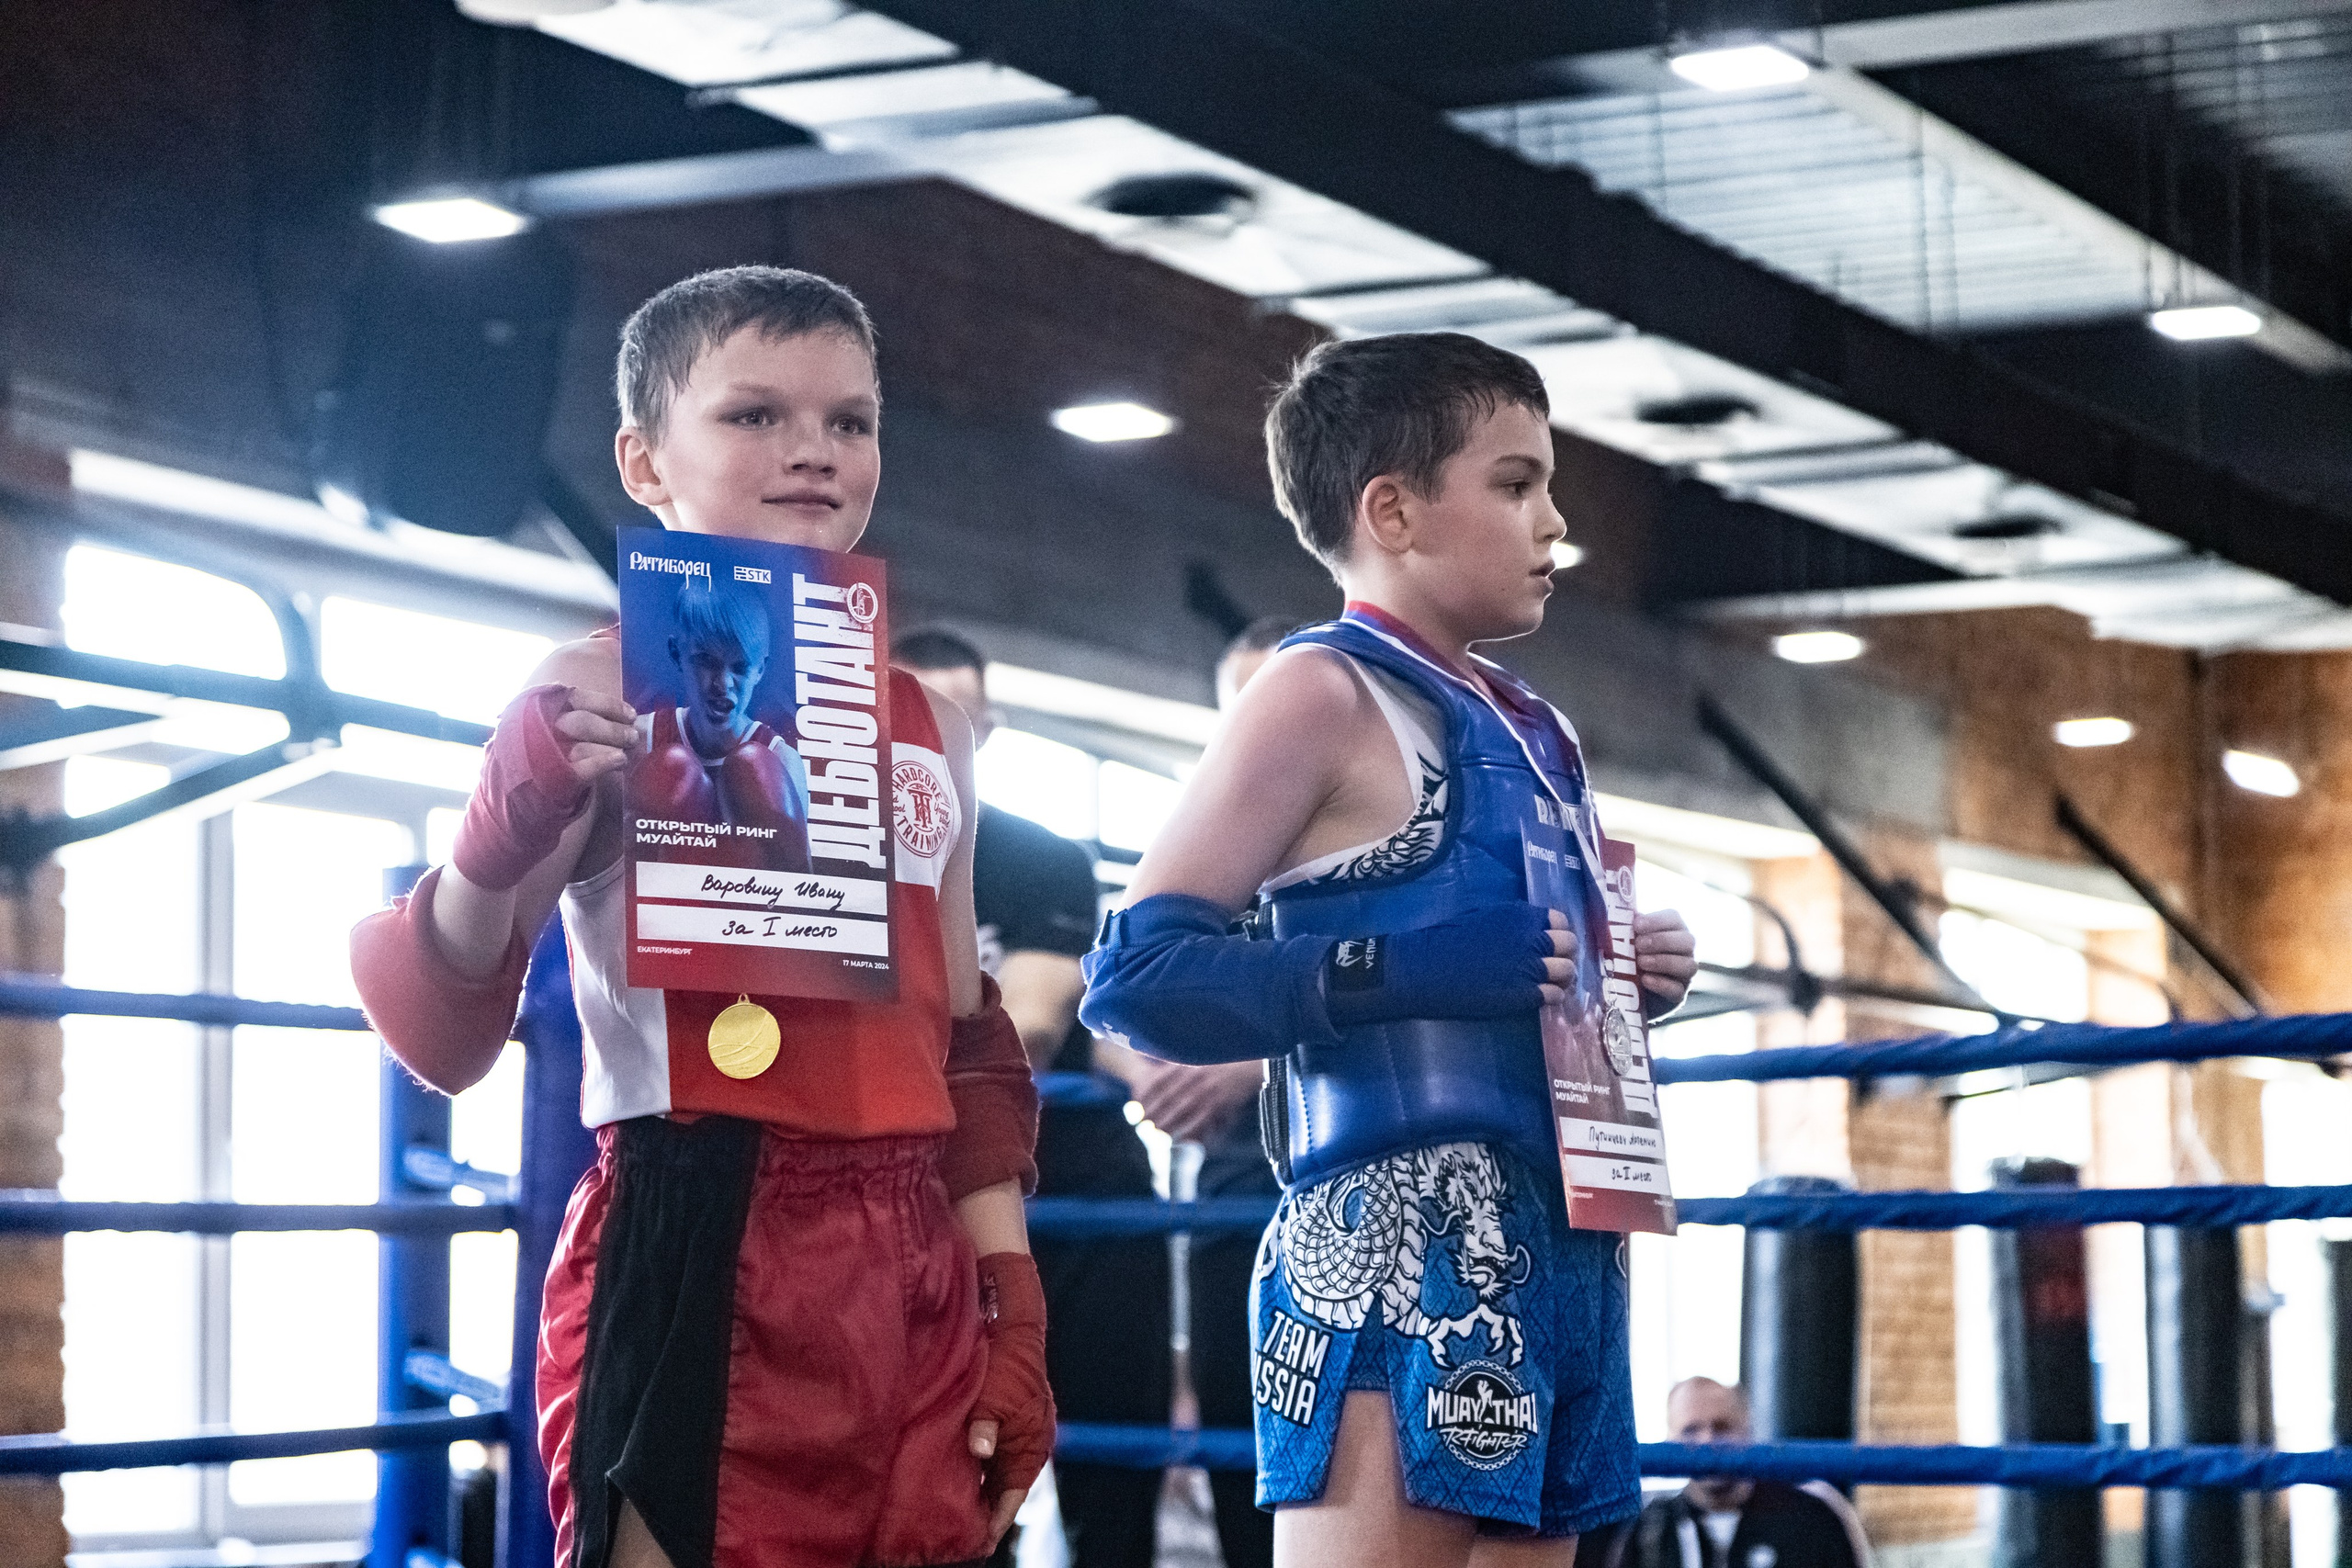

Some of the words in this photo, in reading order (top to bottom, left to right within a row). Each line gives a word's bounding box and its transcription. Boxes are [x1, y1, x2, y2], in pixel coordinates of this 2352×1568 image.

[747, 570, 770, 582] STK
[792, 572, 887, 869] ДЕБЮТАНТ
[892, 767, 943, 801] HARDCORE
[636, 818, 731, 835] ОТКРЫТЫЙ
[736, 826, 777, 839] РИНГ
[897, 816, 944, 851] TRAINING
[636, 832, 717, 848] МУАЙТАЙ
[721, 920, 754, 936] за
[785, 924, 838, 938] место
[637, 945, 693, 956] ЕКАТЕРИНБУРГ
[1365, 937, 1377, 969] VENUM
[842, 959, 850, 967] 17
[851, 960, 873, 970] МАРТА
[874, 962, 889, 970] 2024
[1554, 1078, 1593, 1093] ОТКРЫТЫЙ
[1593, 1084, 1611, 1096] РИНГ
[1555, 1091, 1589, 1104] МУАЙТАЙ
[1262, 1310, 1330, 1379] TEAM
[1427, 1386, 1482, 1429] MUAY
[1491, 1392, 1538, 1435] THAI
